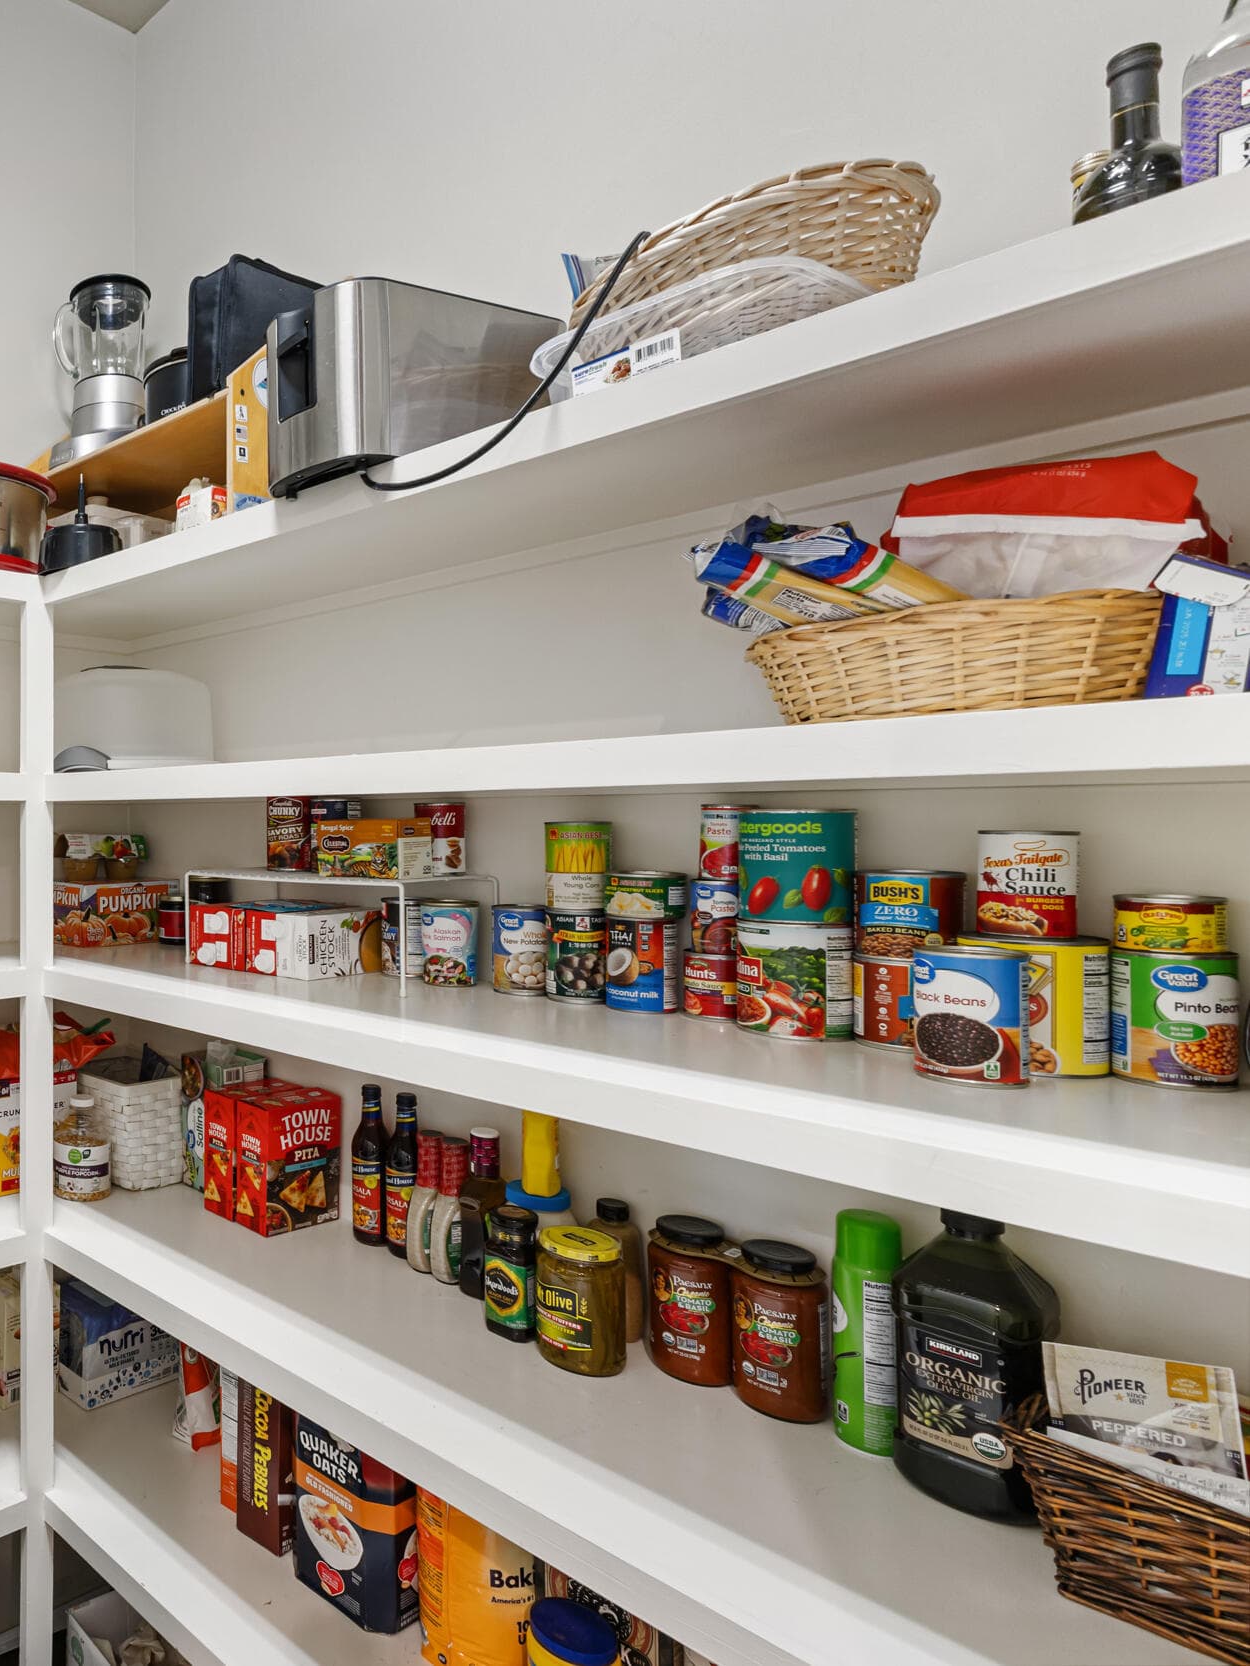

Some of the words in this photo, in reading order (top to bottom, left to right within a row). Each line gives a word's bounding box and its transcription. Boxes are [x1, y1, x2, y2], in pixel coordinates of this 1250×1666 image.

[268, 805, 300, 817] CHUNKY
[320, 824, 338, 833] Bengal
[339, 824, 354, 832] Spice
[706, 827, 731, 836] Paste
[743, 844, 770, 852] Peeled
[773, 844, 826, 853] Tomatoes
[744, 853, 761, 861] with
[763, 853, 788, 861] Basil
[983, 856, 1013, 868] Texas
[1014, 853, 1063, 867] Tailgate
[1005, 867, 1057, 883] Chili
[120, 886, 147, 894] ORGANIC
[873, 885, 920, 900] BUSH'S
[1004, 882, 1066, 897] Sauce
[100, 892, 167, 913] PUMPKI
[710, 905, 735, 913] Paste
[875, 905, 918, 917] ZERO
[433, 934, 461, 942] Salmon
[610, 930, 633, 940] THAI
[895, 927, 927, 936] BEANS
[320, 919, 328, 975] CHICKEN
[327, 925, 336, 968] STOCK
[685, 967, 717, 980] Hunt's
[1158, 970, 1199, 982] Great
[702, 982, 726, 991] Sauce
[1168, 978, 1199, 988] Value
[608, 988, 638, 999] coconut
[640, 990, 659, 999] milk
[944, 991, 987, 1007] Beans
[1175, 1001, 1212, 1014] Pinto
[281, 1108, 331, 1132] TOWN
[209, 1122, 227, 1134] TOWN
[208, 1128, 227, 1142] HOUSE
[241, 1133, 260, 1146] TOWN
[279, 1125, 332, 1151] HOUSE
[212, 1138, 224, 1148] PITA
[241, 1140, 261, 1155] HOUSE
[245, 1151, 258, 1160] PITA
[293, 1147, 320, 1162] PITA
[546, 1289, 573, 1311] Olive
[677, 1295, 712, 1307] TOMATO
[685, 1302, 710, 1312] BASIL
[757, 1323, 796, 1338] TOMATO
[99, 1327, 144, 1356] nurri
[765, 1332, 793, 1344] BASIL
[929, 1340, 980, 1361] KIRKLAND
[905, 1352, 1007, 1394] ORGANIC
[916, 1368, 954, 1388] EXTRA
[955, 1380, 994, 1400] VIRGIN
[1074, 1368, 1147, 1406] PIONEER
[926, 1380, 960, 1397] OLIVE
[962, 1389, 981, 1404] OIL
[1092, 1419, 1187, 1448] PEPPERED
[979, 1436, 1000, 1449] USDA
[312, 1453, 346, 1484] OATS
[253, 1443, 272, 1511] PEBBLES
[305, 1477, 319, 1490] OLD
[320, 1483, 353, 1513] FASHIONED
[491, 1596, 527, 1605] America's
